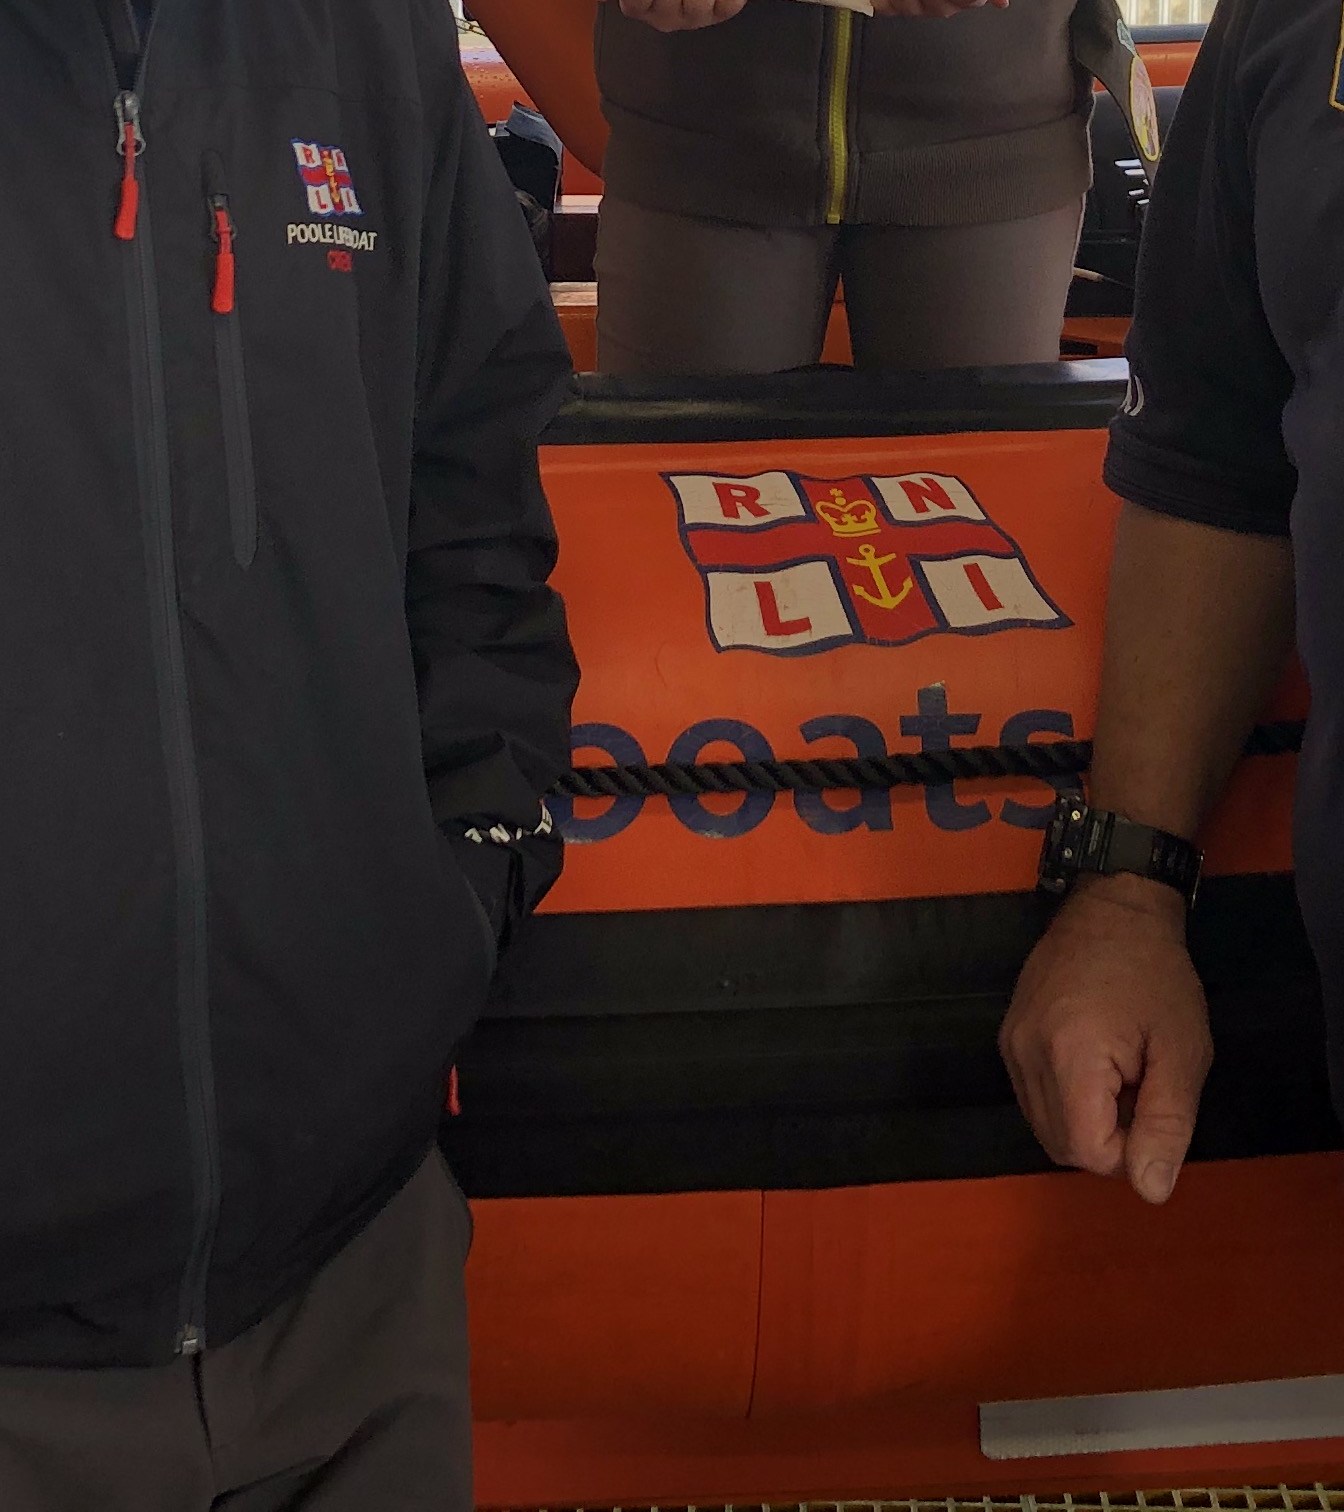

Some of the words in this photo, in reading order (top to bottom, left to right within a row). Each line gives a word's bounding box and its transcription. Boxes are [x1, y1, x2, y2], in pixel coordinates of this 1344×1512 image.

[287, 223, 334, 245] POOLE
[711, 480, 772, 519] R
[899, 477, 957, 514] N
[752, 580, 813, 637] L
[962, 562, 1006, 611] I
